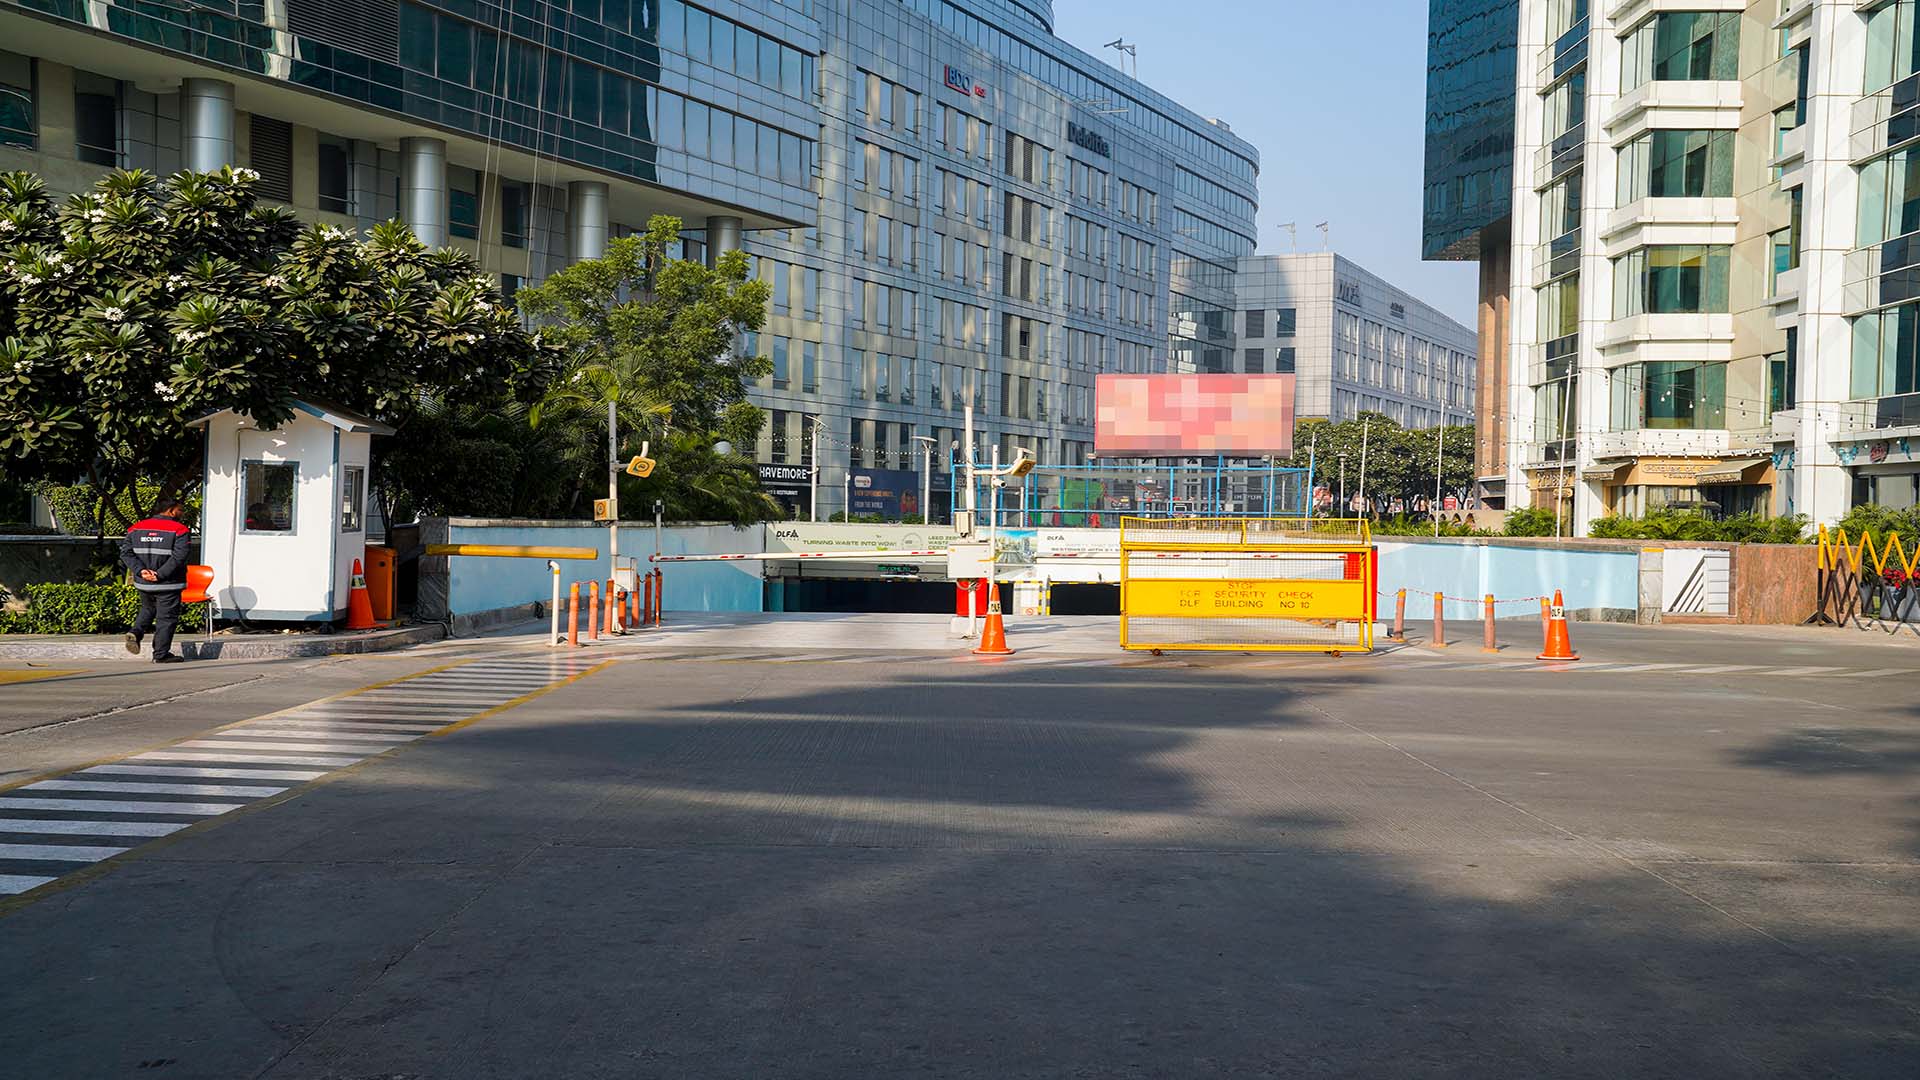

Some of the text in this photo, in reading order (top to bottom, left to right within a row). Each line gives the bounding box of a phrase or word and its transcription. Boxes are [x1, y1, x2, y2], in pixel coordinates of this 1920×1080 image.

[949, 66, 971, 92] BDO
[760, 466, 807, 479] HAVEMORE
[1214, 589, 1267, 599] SECURITY
[1278, 591, 1313, 600] CHECK
[1179, 599, 1311, 609] DLF BUILDING NO 10
